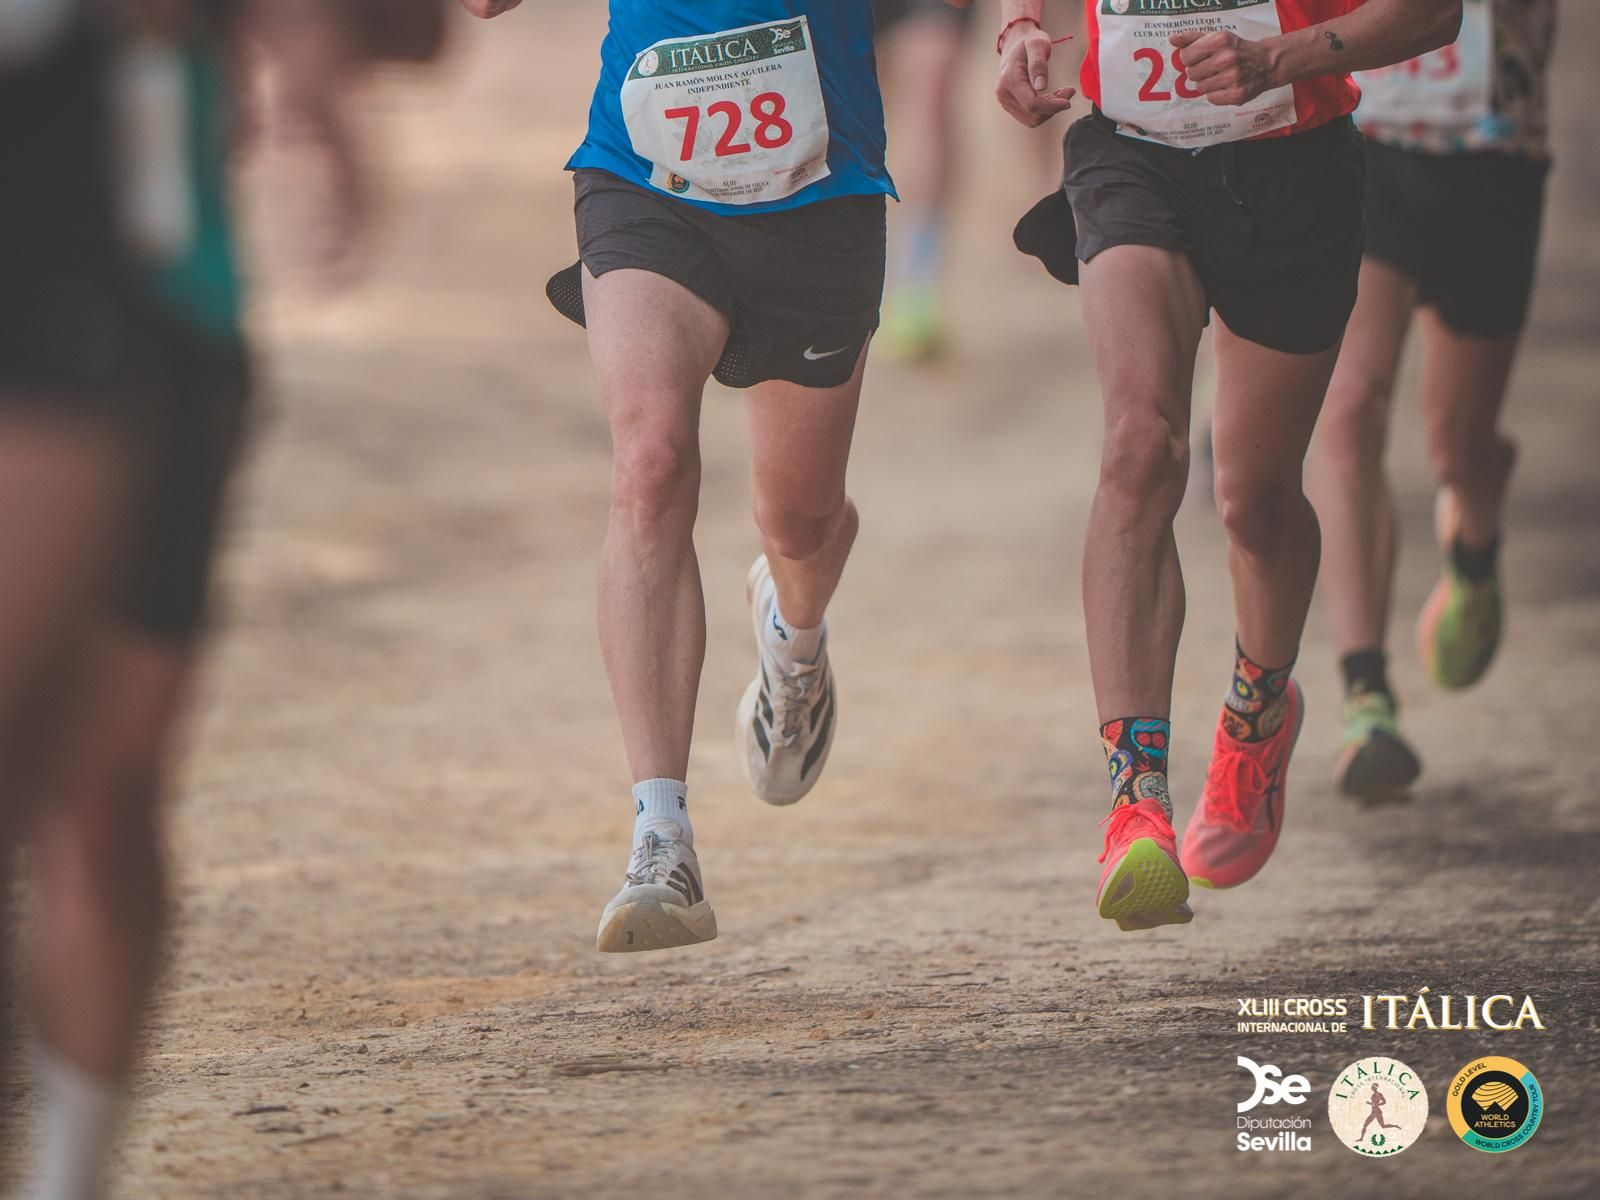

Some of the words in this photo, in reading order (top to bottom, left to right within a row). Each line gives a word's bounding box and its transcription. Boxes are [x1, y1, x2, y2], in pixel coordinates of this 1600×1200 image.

[1163, 19, 1195, 29] MERINO
[670, 37, 758, 68] ITÁLICA
[654, 81, 675, 90] JUAN
[676, 76, 705, 88] RAMÓN
[706, 71, 739, 83] MOLINA
[740, 63, 783, 78] AGUILERA
[687, 79, 752, 95] INDEPENDIENTE
[664, 91, 794, 162] 728
